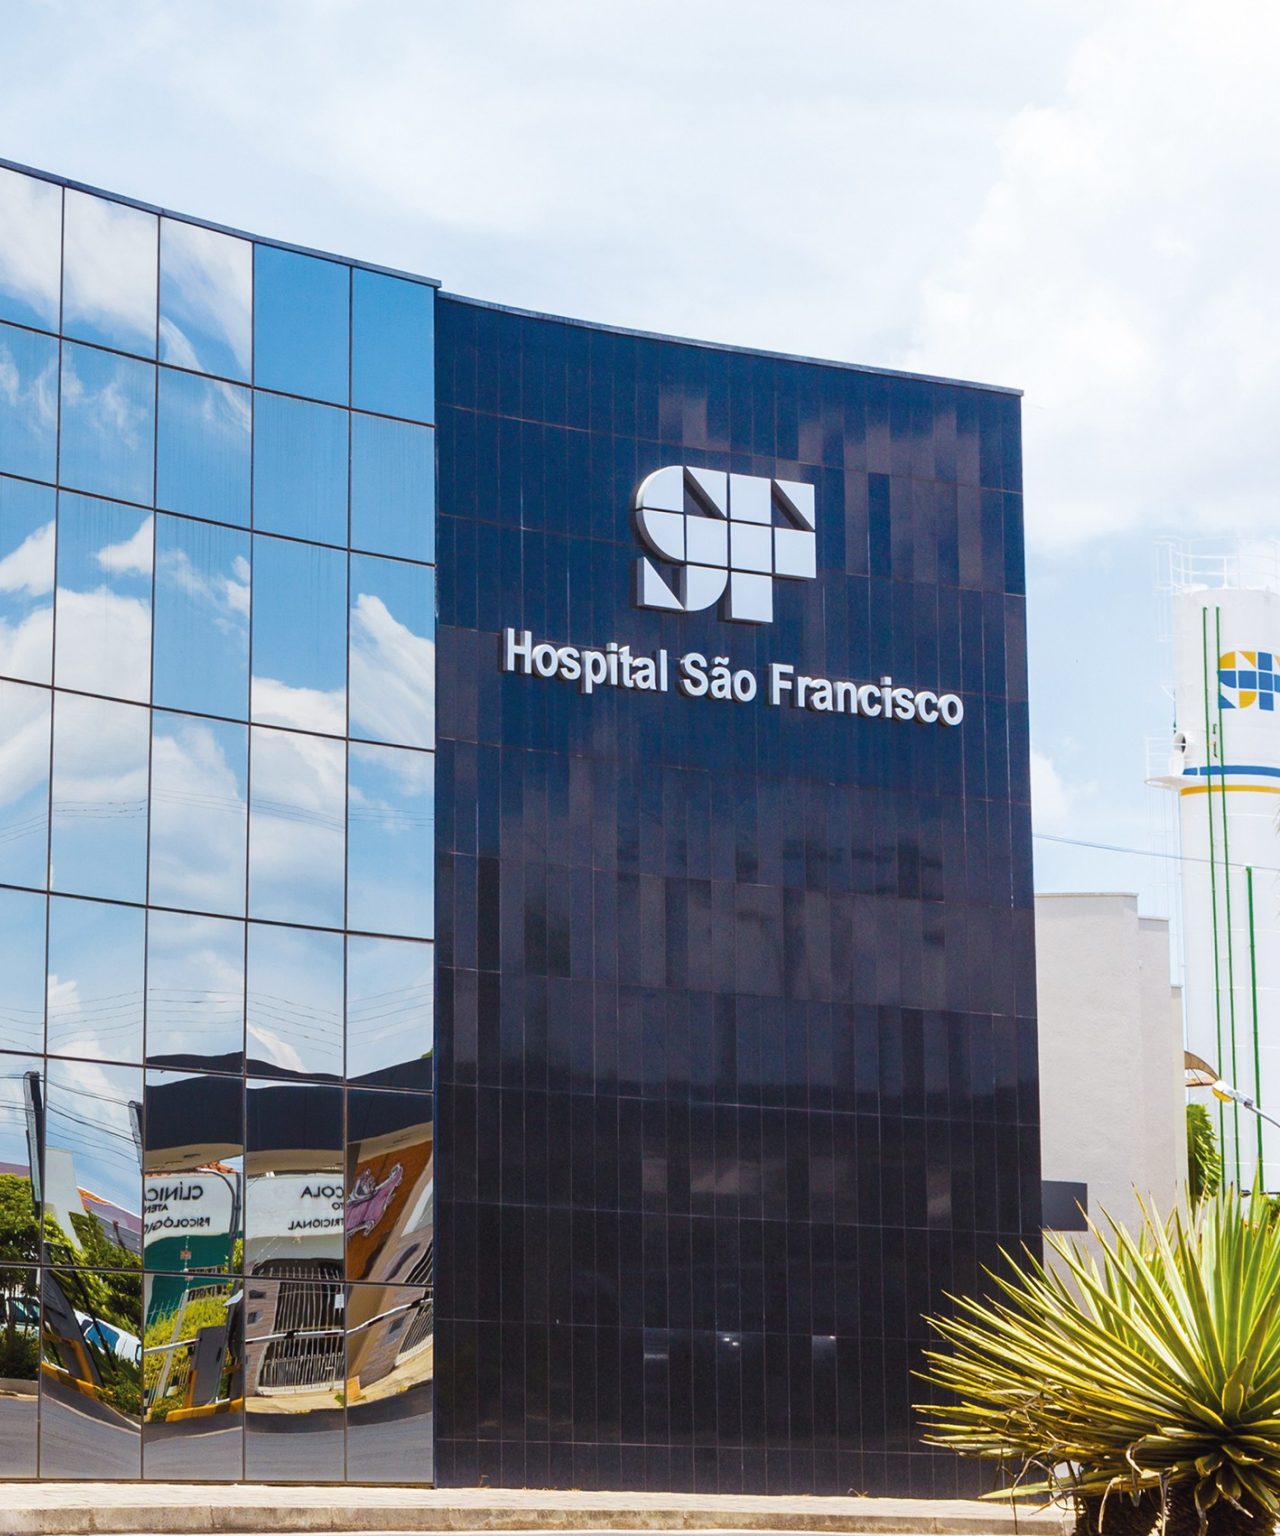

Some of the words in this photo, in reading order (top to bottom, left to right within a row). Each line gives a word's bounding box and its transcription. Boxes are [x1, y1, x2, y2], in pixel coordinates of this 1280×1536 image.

[503, 627, 668, 694] Hospital
[680, 652, 757, 702] São
[770, 663, 964, 726] Francisco
